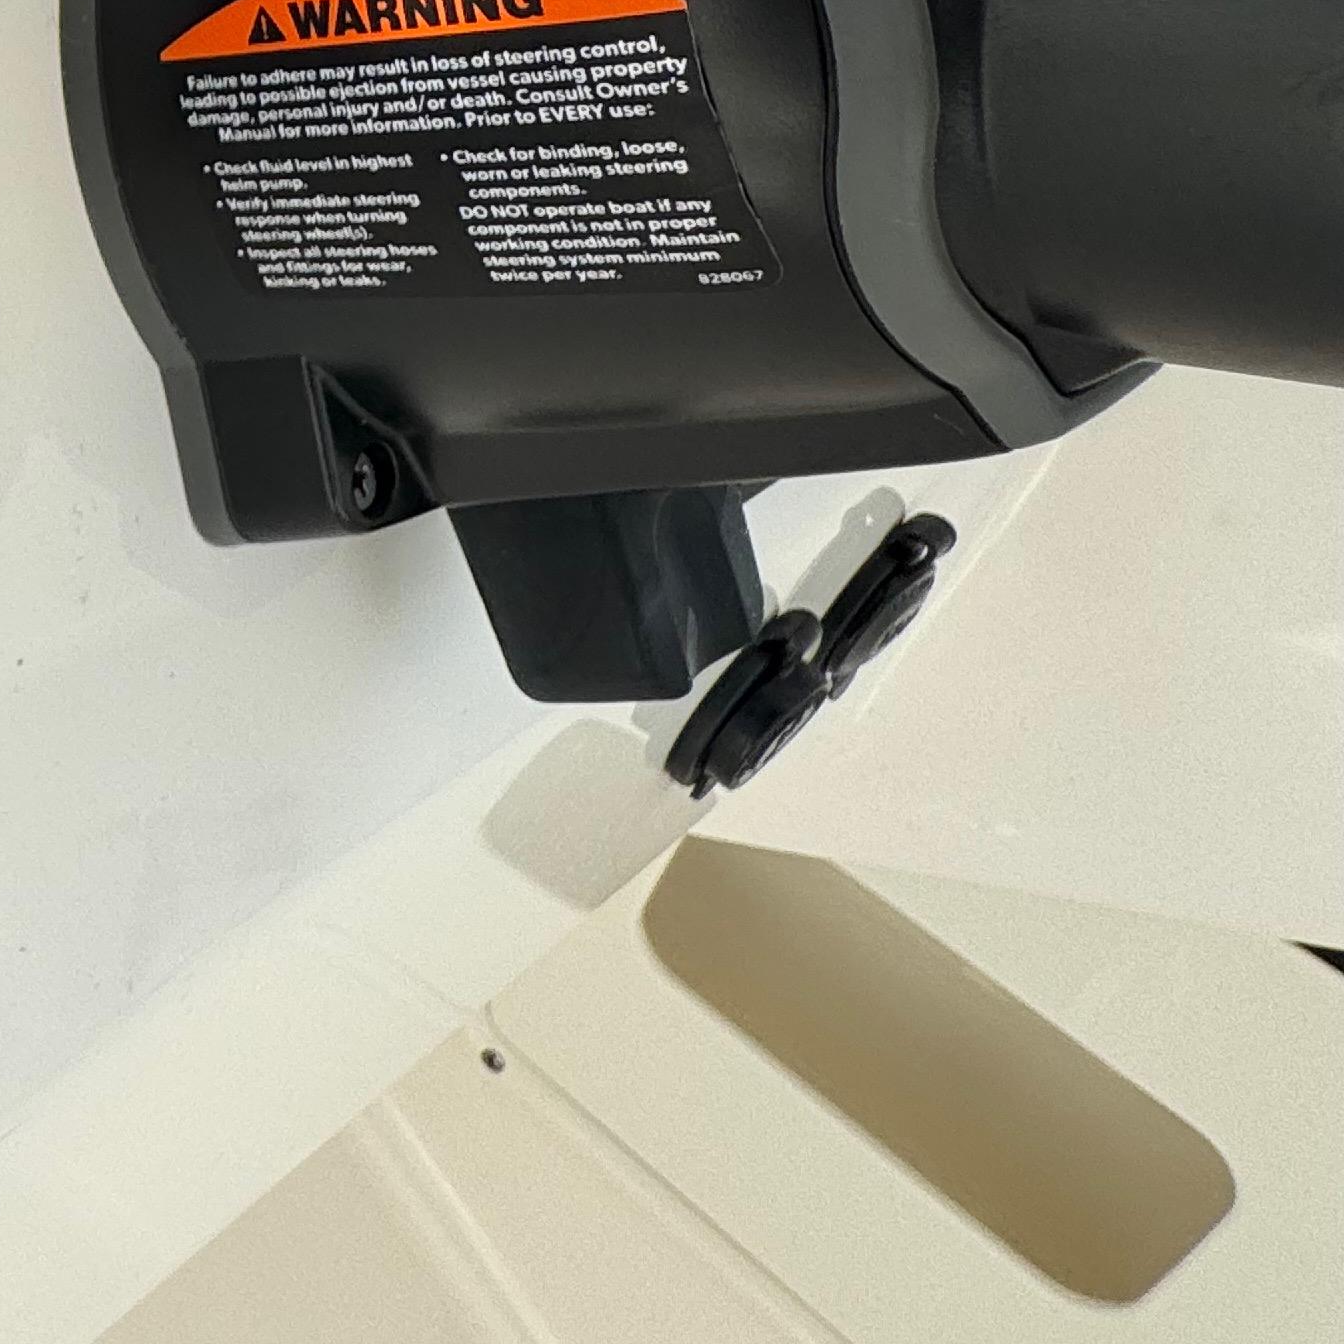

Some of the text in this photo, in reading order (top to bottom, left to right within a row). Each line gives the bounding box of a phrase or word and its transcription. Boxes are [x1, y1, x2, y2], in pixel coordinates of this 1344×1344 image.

[186, 35, 666, 92] Failure to adhere may result in loss of steering control,
[179, 57, 688, 110] leading to possible ejection from vessel causing property
[186, 110, 255, 128] damage,
[258, 106, 328, 125] personal
[330, 101, 379, 120] injury
[450, 93, 512, 110] death.
[515, 85, 594, 106] Consult
[596, 77, 689, 99] Owner's
[218, 102, 656, 143] Manual for more information. Prior to EVERY use:
[452, 139, 685, 165] Check for binding, loose,
[214, 153, 413, 176] Check fluid level in highest
[461, 158, 688, 182] worn or leaking steering
[220, 178, 258, 192] helm
[468, 183, 587, 200] components.
[225, 190, 421, 213] Verify immediate steering
[459, 198, 712, 220] DO NOT operate boat if any
[235, 208, 408, 229] response when turning
[467, 215, 717, 237] component is not in proper
[241, 229, 302, 244] steering
[474, 237, 550, 253] working
[648, 230, 741, 247] Maintain
[324, 244, 388, 261] steering
[388, 242, 439, 256] hoses
[482, 249, 721, 269] steering system minimum
[489, 267, 623, 283] twice per year.
